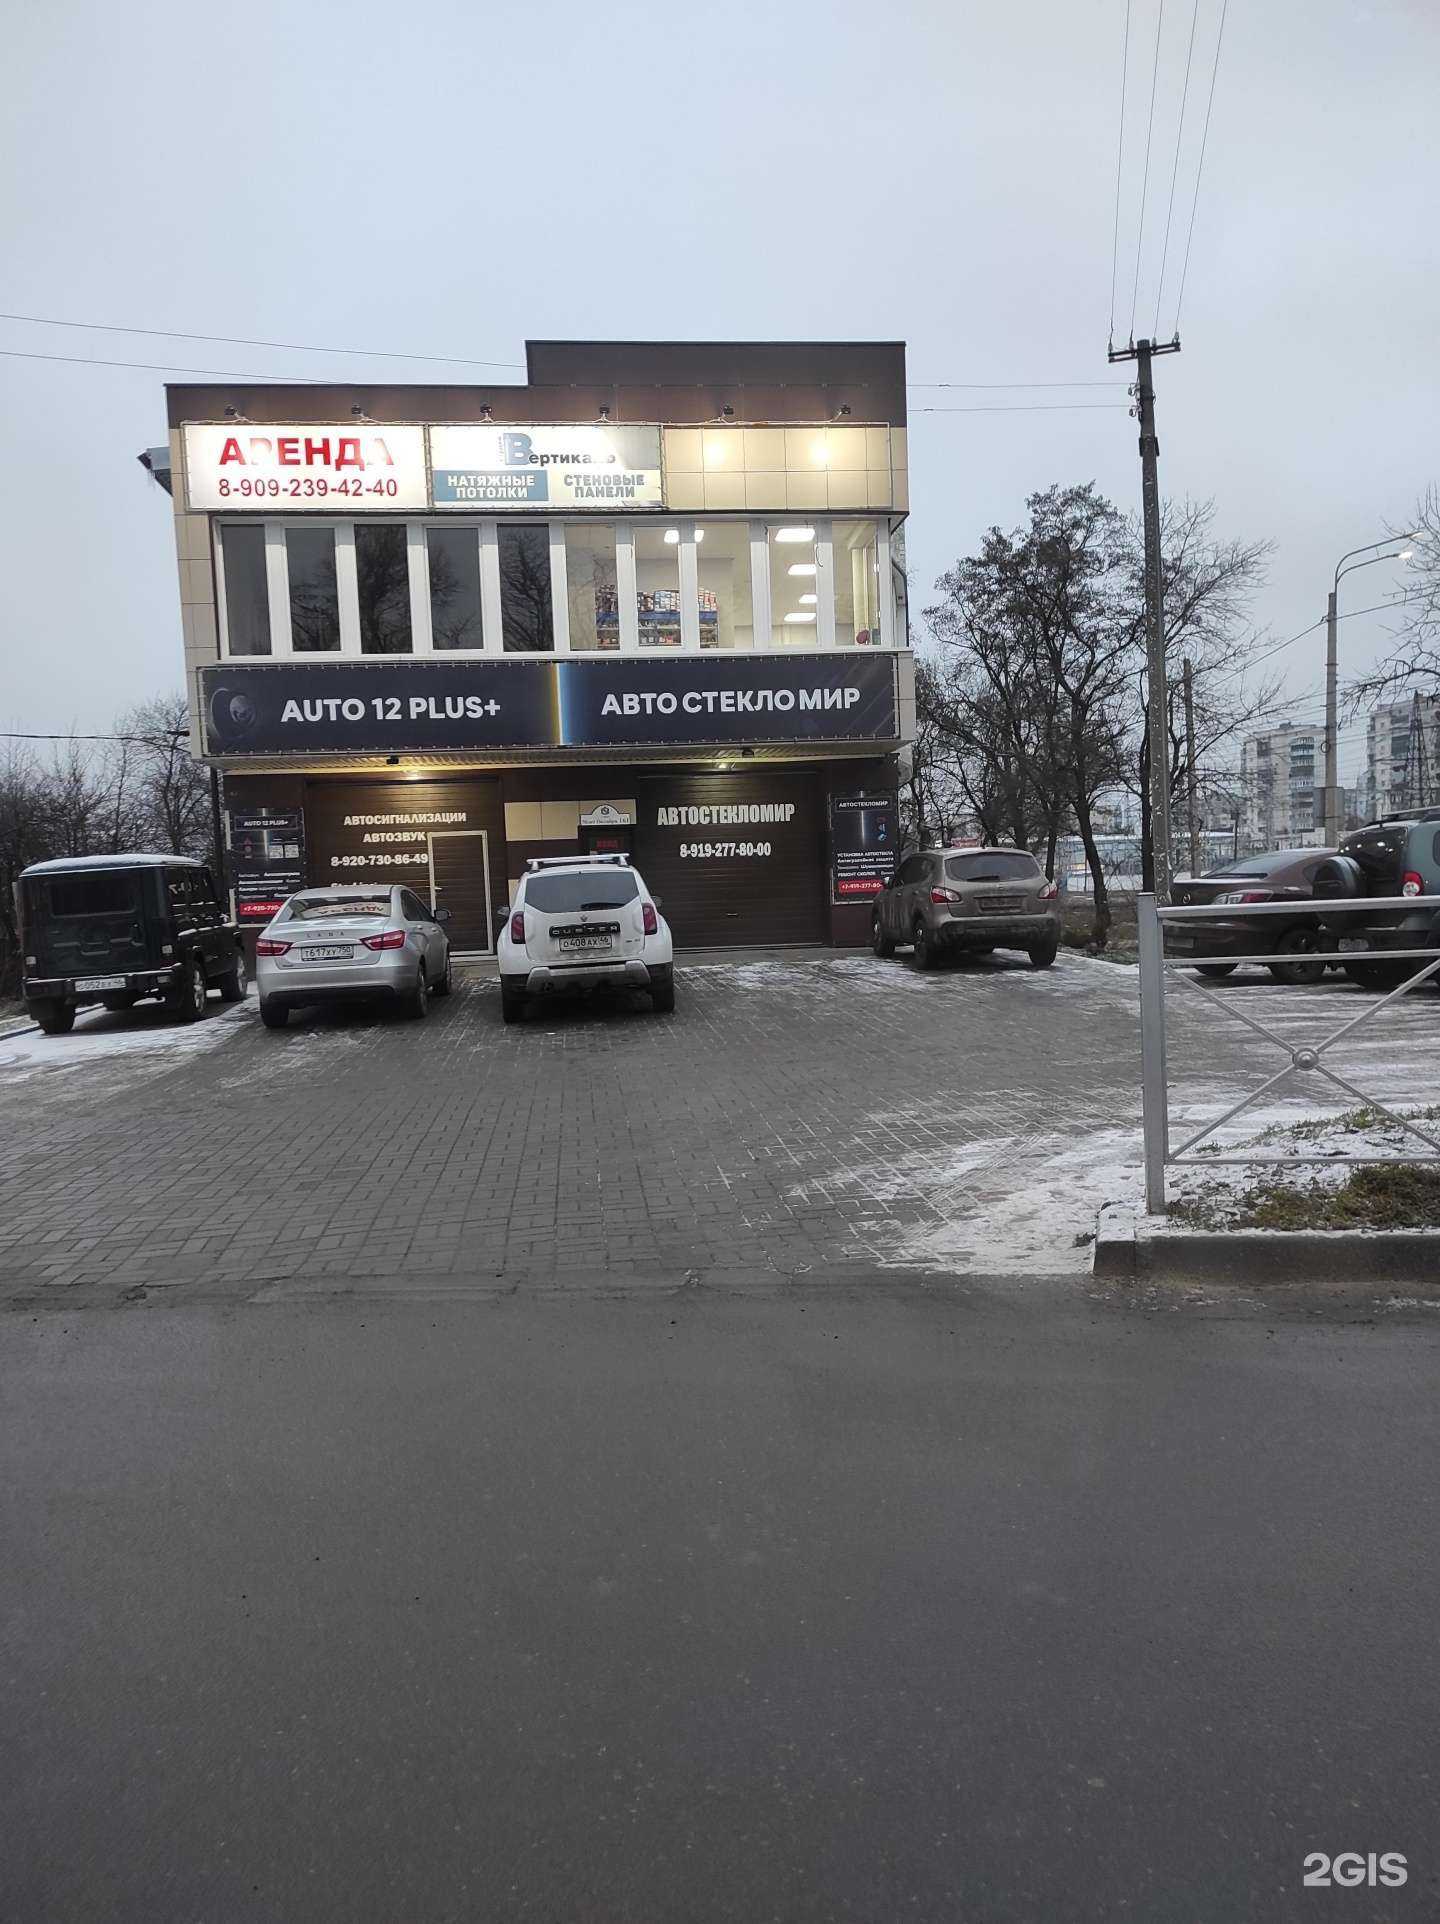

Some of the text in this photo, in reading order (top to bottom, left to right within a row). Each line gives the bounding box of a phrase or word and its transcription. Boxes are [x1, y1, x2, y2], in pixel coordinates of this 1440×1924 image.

[502, 432, 616, 466] Вертикаь
[447, 475, 535, 487] НАТЯЖНЫЕ
[563, 474, 645, 486] СТЕНОВЫЕ
[219, 478, 398, 497] 8-909-239-42-40
[456, 487, 528, 498] ПОТОЛКИ
[574, 486, 635, 498] ПАНЕЛИ
[280, 697, 501, 723] AUTO 12 PLUS+
[343, 812, 467, 826] АВТОСИГНАЛИЗАЦИИ
[657, 803, 796, 826] АВТОСТЕКЛОМИР
[362, 831, 427, 843] АВТОЗВУК
[679, 842, 773, 858] 8-919-277-80-00
[330, 853, 429, 867] 8-920-730-86-49
